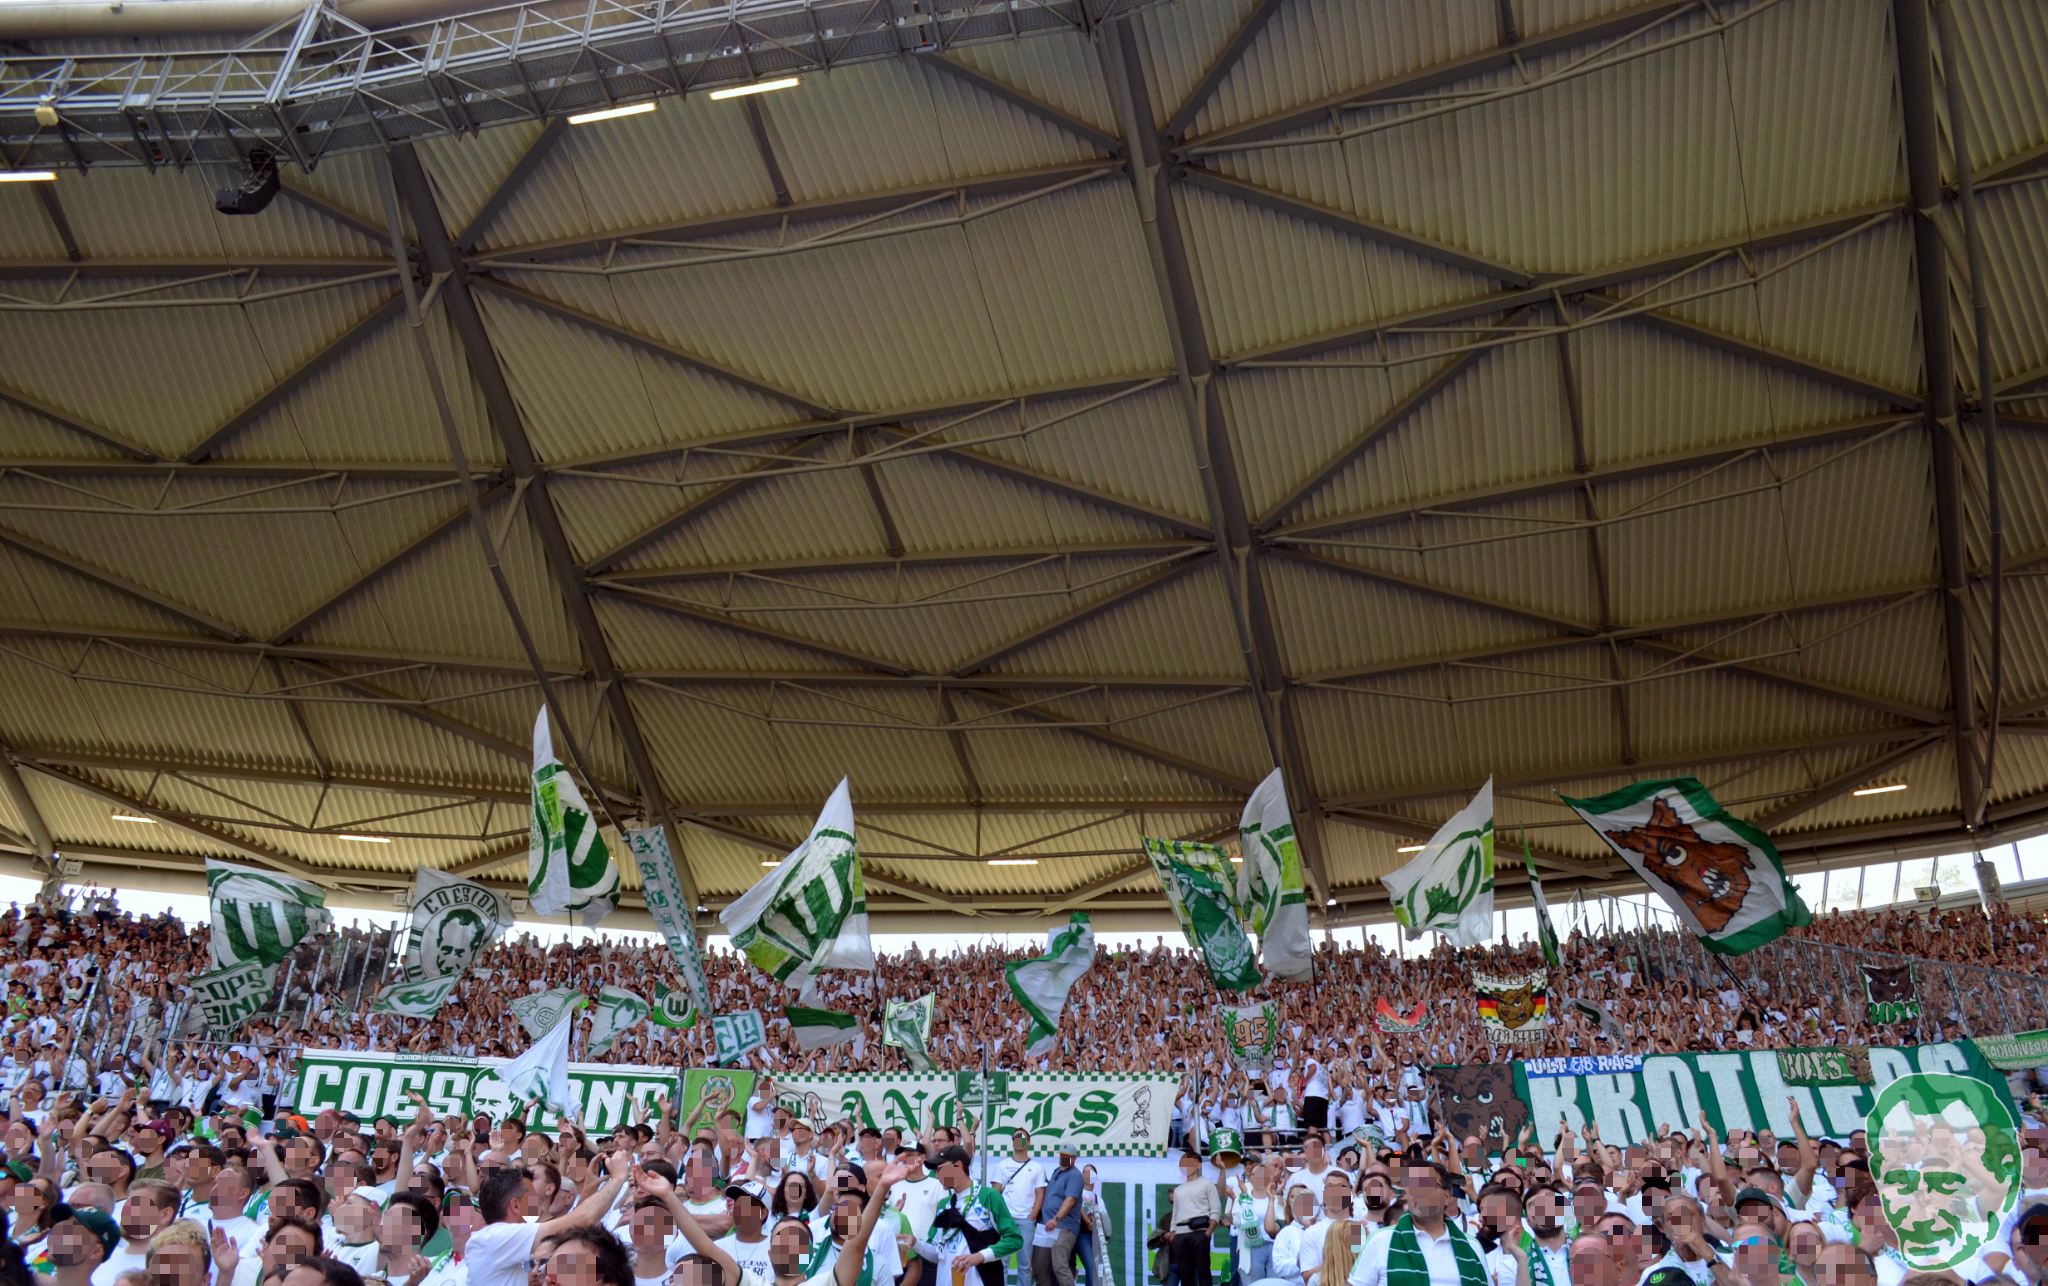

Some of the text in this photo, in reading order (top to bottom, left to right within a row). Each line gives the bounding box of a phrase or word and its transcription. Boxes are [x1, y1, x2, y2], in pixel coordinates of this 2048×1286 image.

[1234, 1017, 1269, 1048] 95
[1597, 1054, 1636, 1072] RAS
[840, 1087, 1120, 1139] ANGELS
